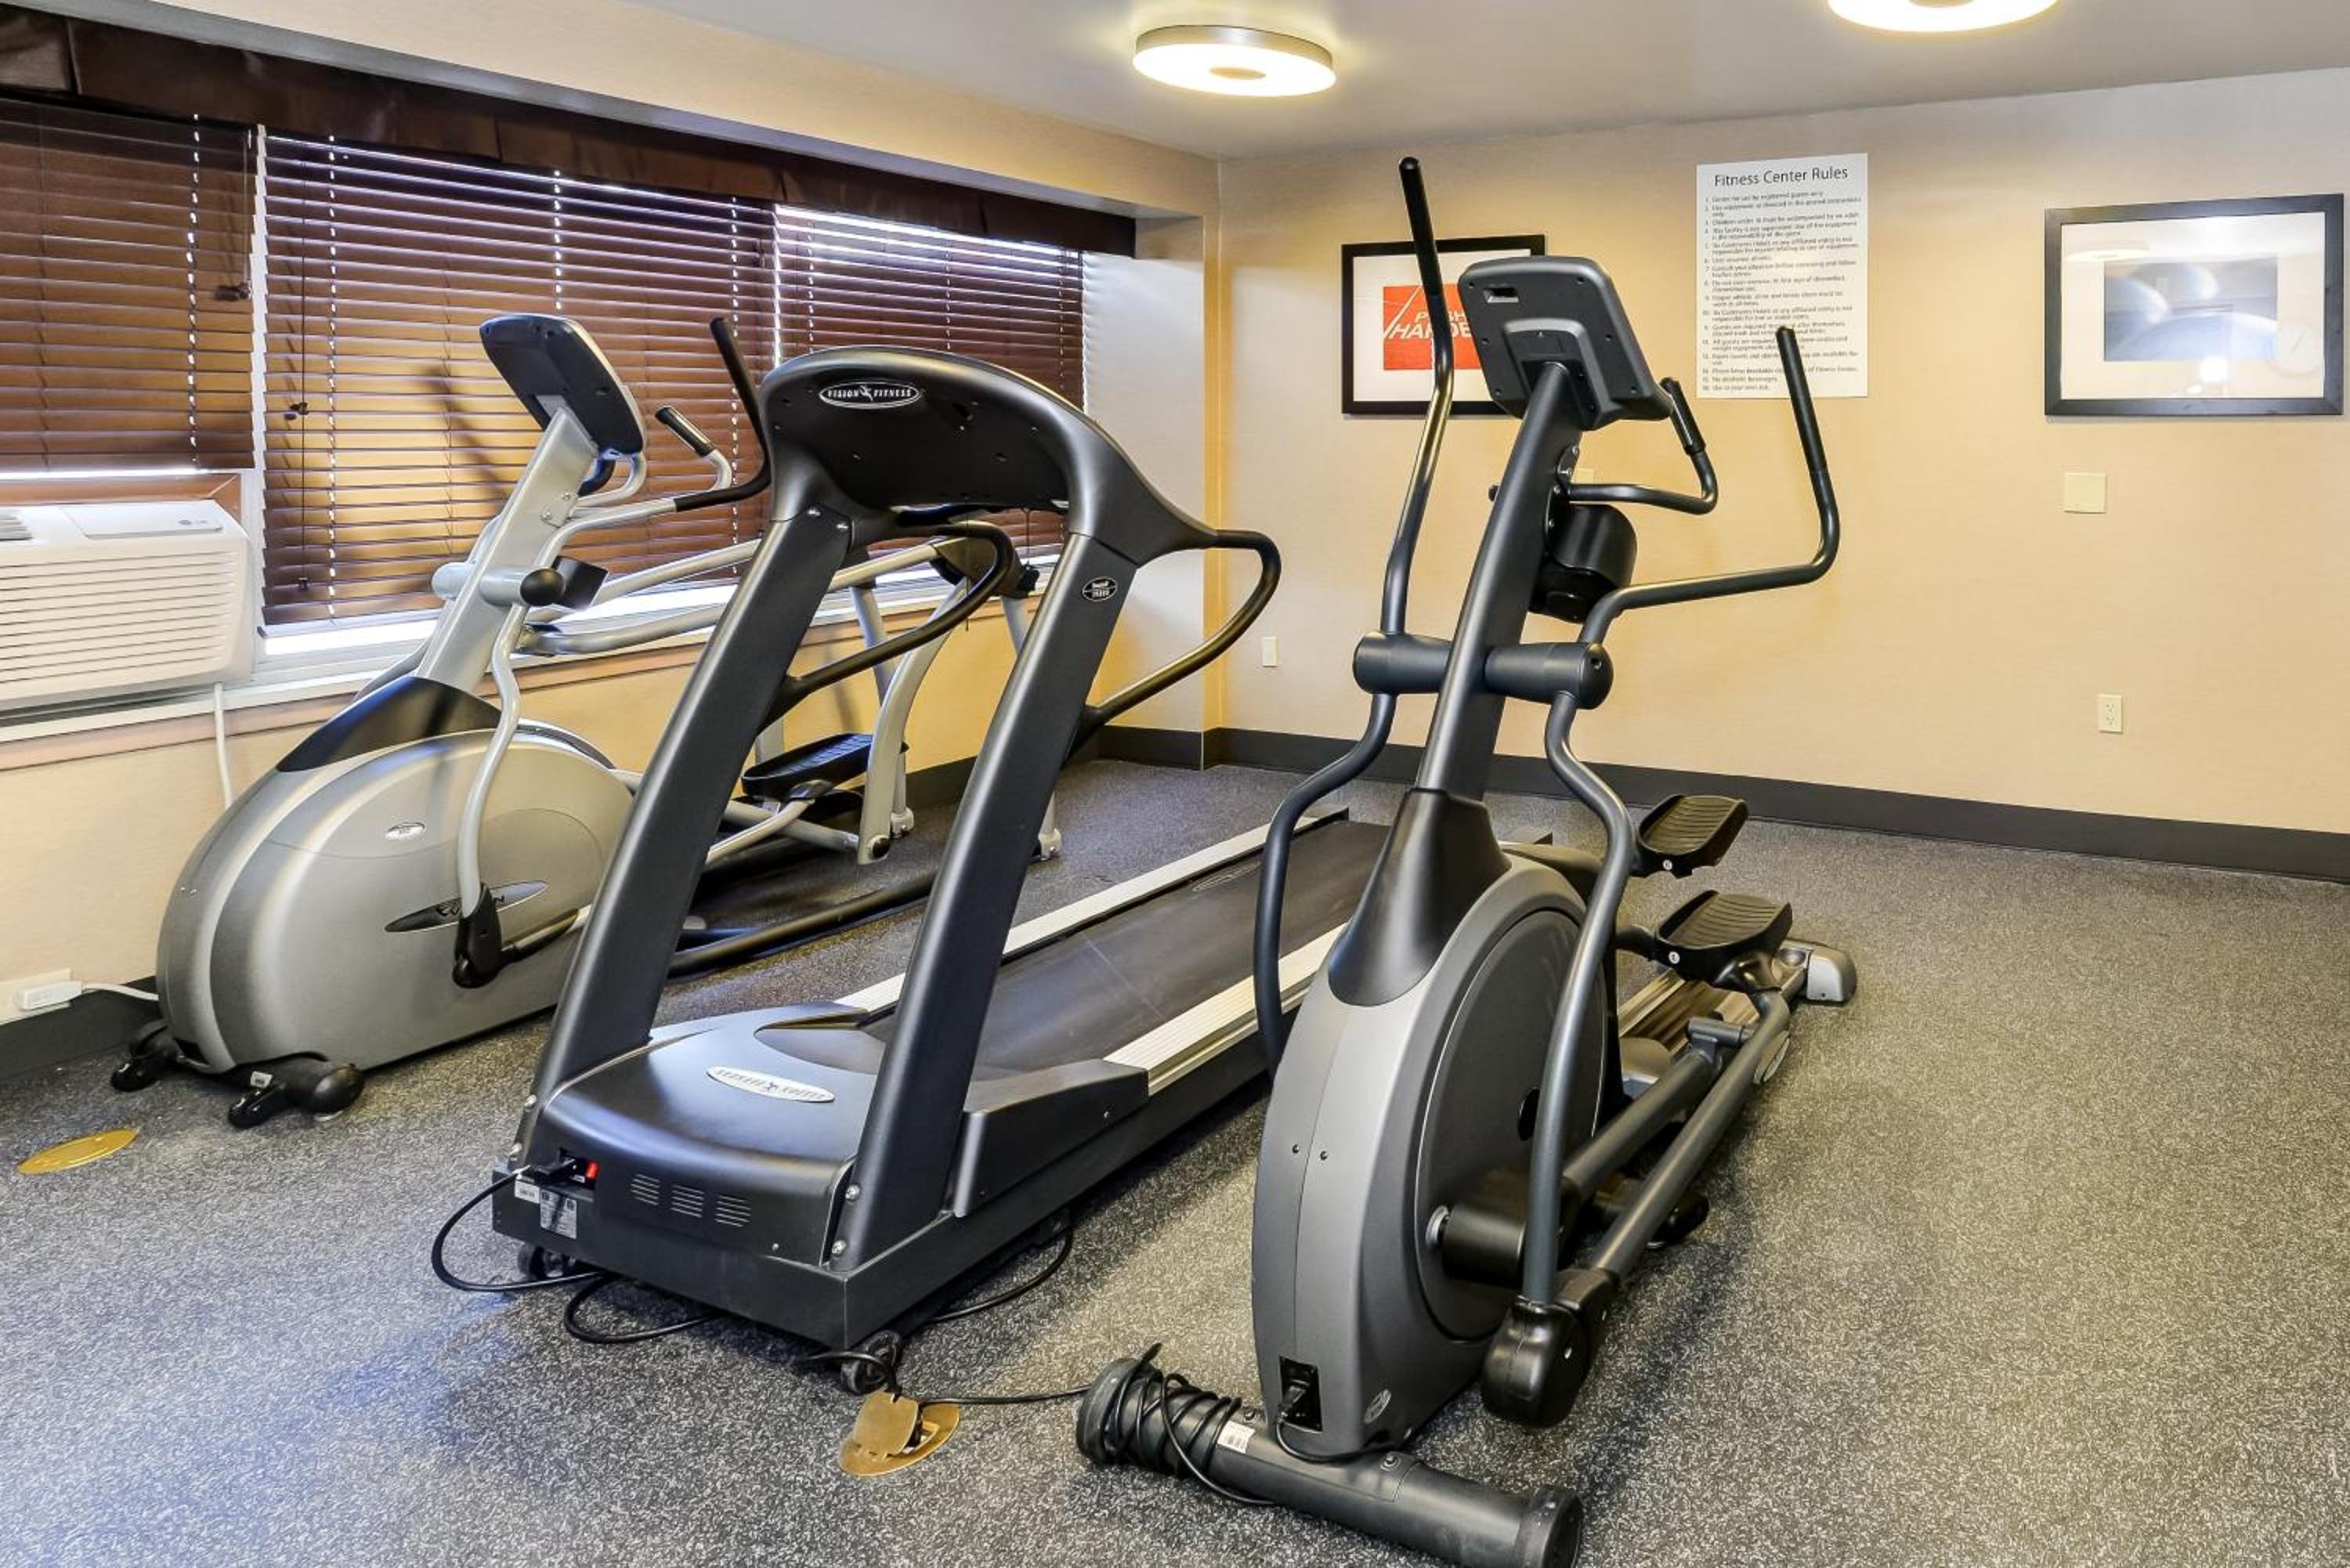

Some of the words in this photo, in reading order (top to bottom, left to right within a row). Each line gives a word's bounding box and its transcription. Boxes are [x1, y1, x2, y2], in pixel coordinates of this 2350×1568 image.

[1714, 173, 1759, 186] Fitness
[1763, 169, 1807, 184] Center
[1812, 166, 1849, 181] Rules
[1415, 311, 1467, 323] PH
[1388, 322, 1473, 338] HADE
[828, 389, 859, 398] VISION
